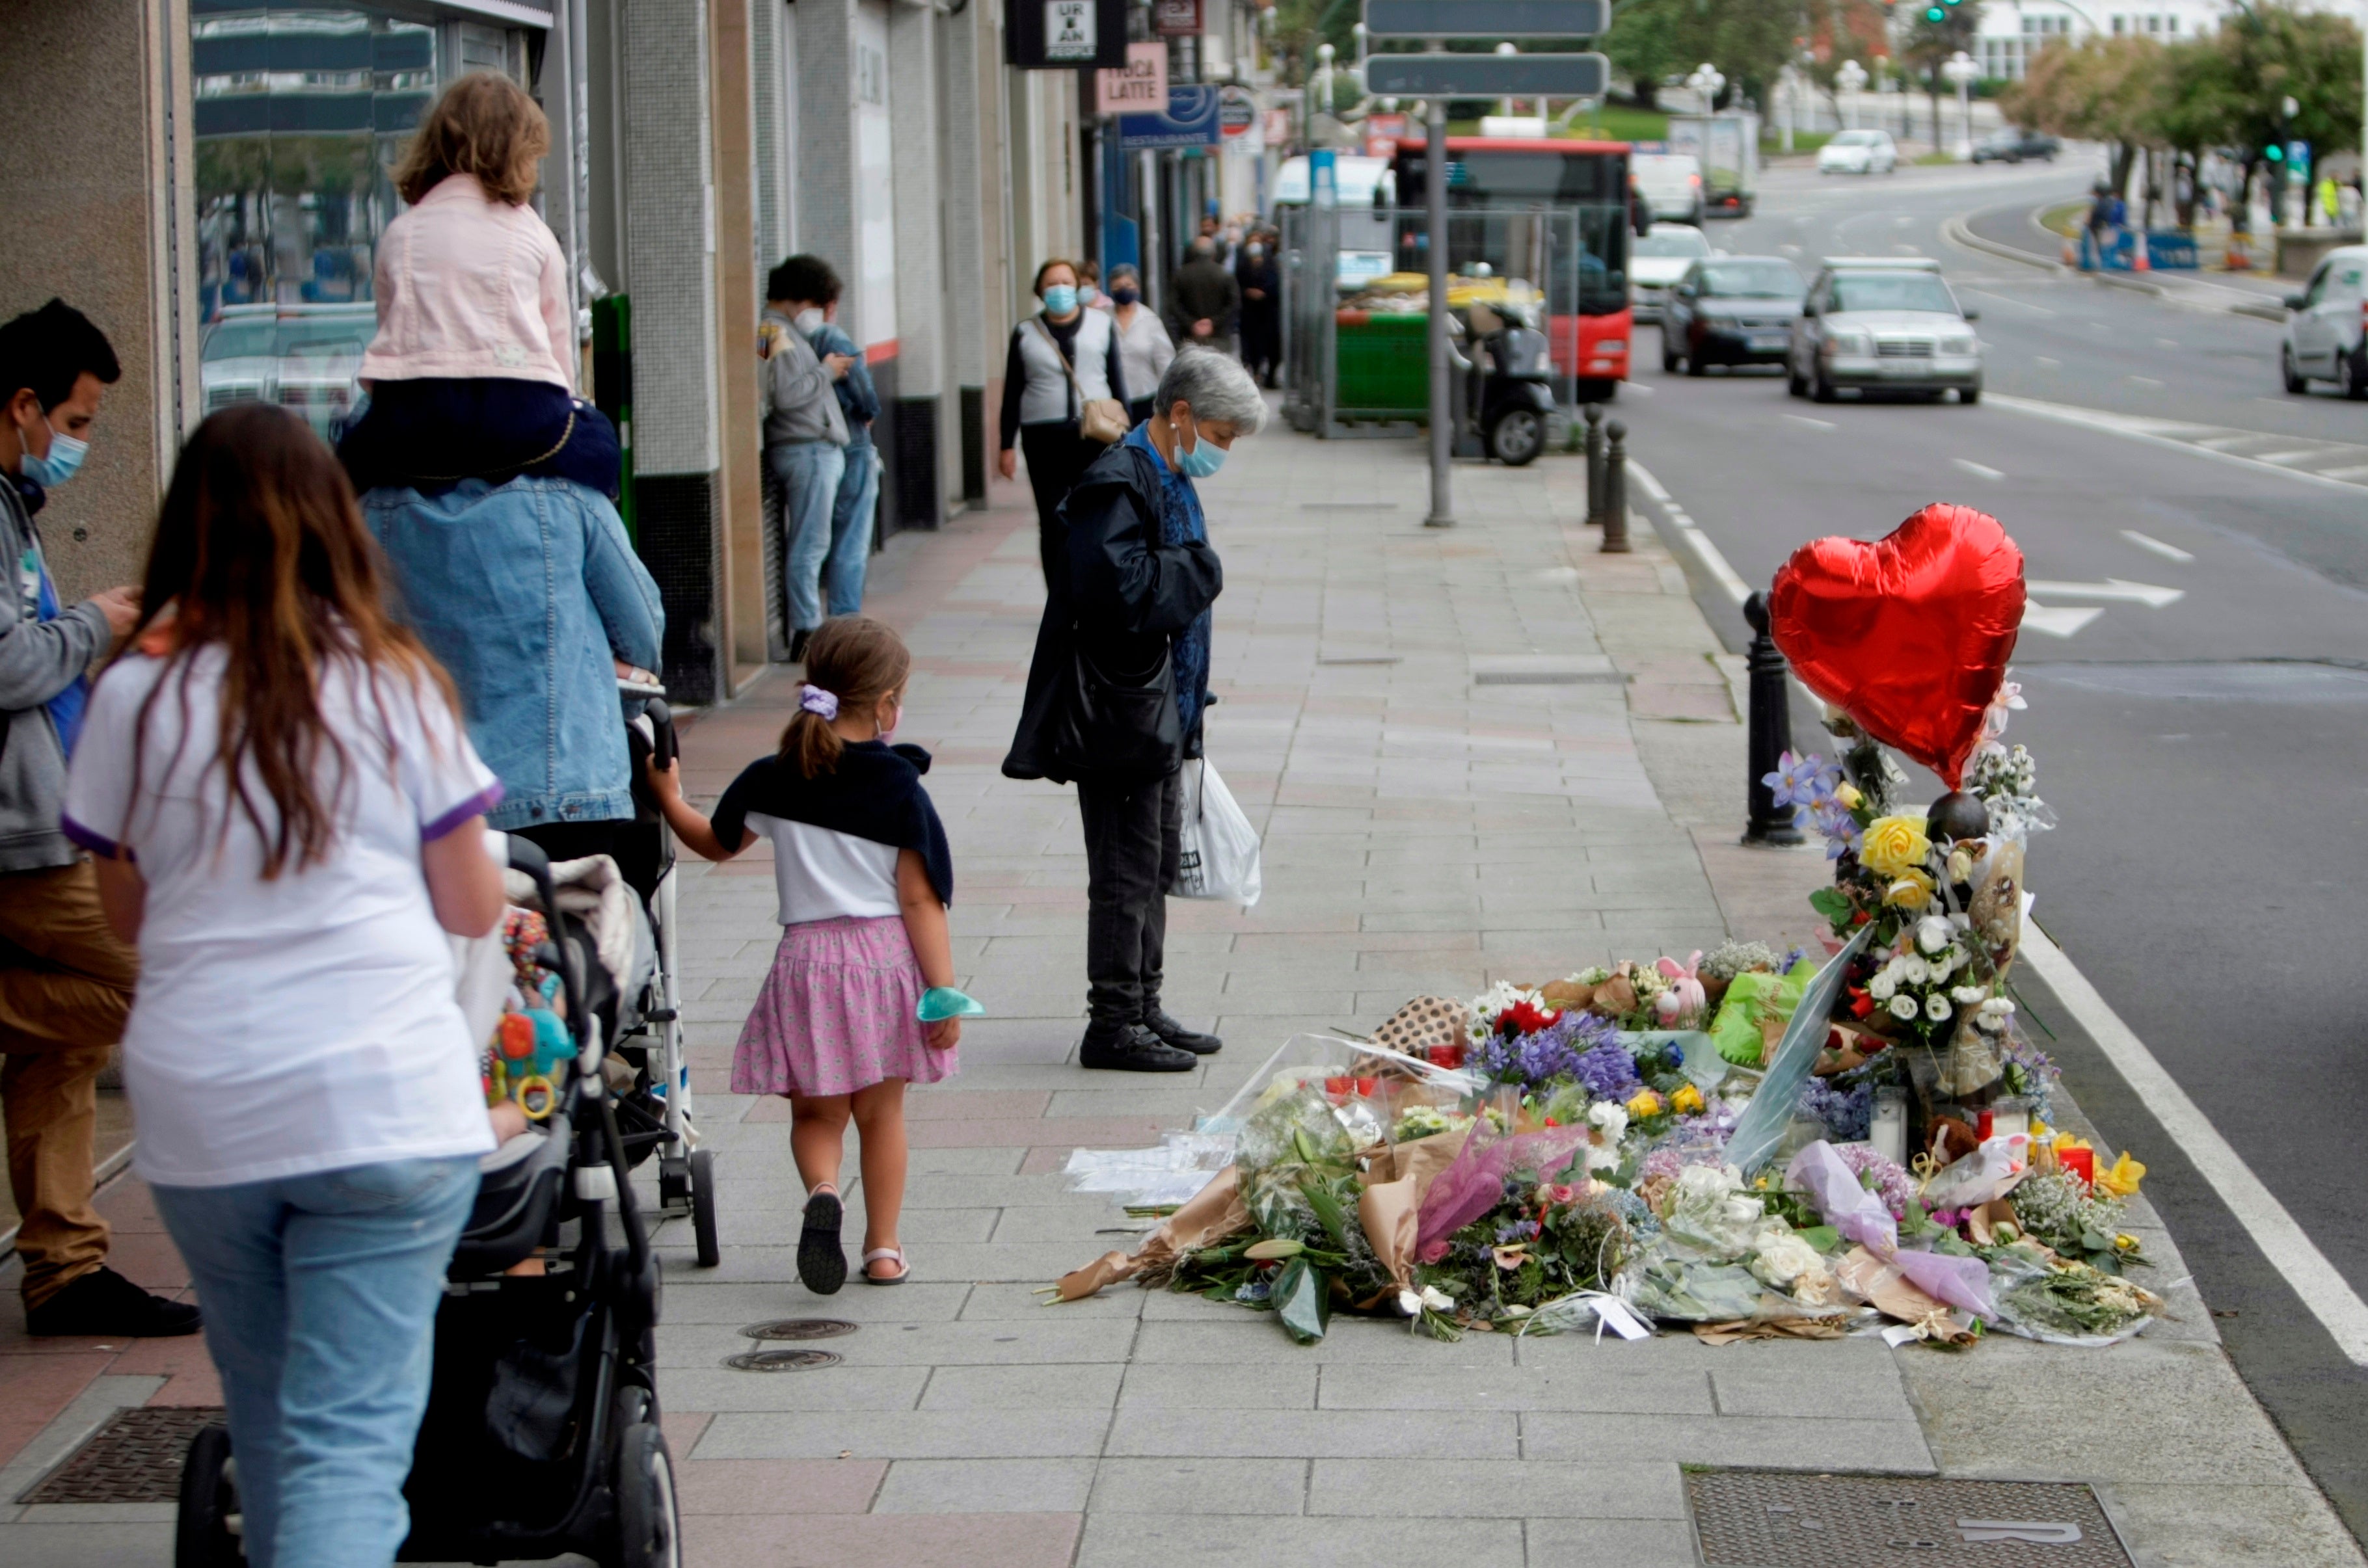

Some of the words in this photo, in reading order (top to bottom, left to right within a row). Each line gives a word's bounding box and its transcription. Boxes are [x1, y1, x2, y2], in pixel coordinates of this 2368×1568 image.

[1058, 3, 1083, 16] UR
[1058, 29, 1084, 42] AN
[1108, 80, 1156, 100] LATTE
[1122, 132, 1208, 146] RESTAURANTE
